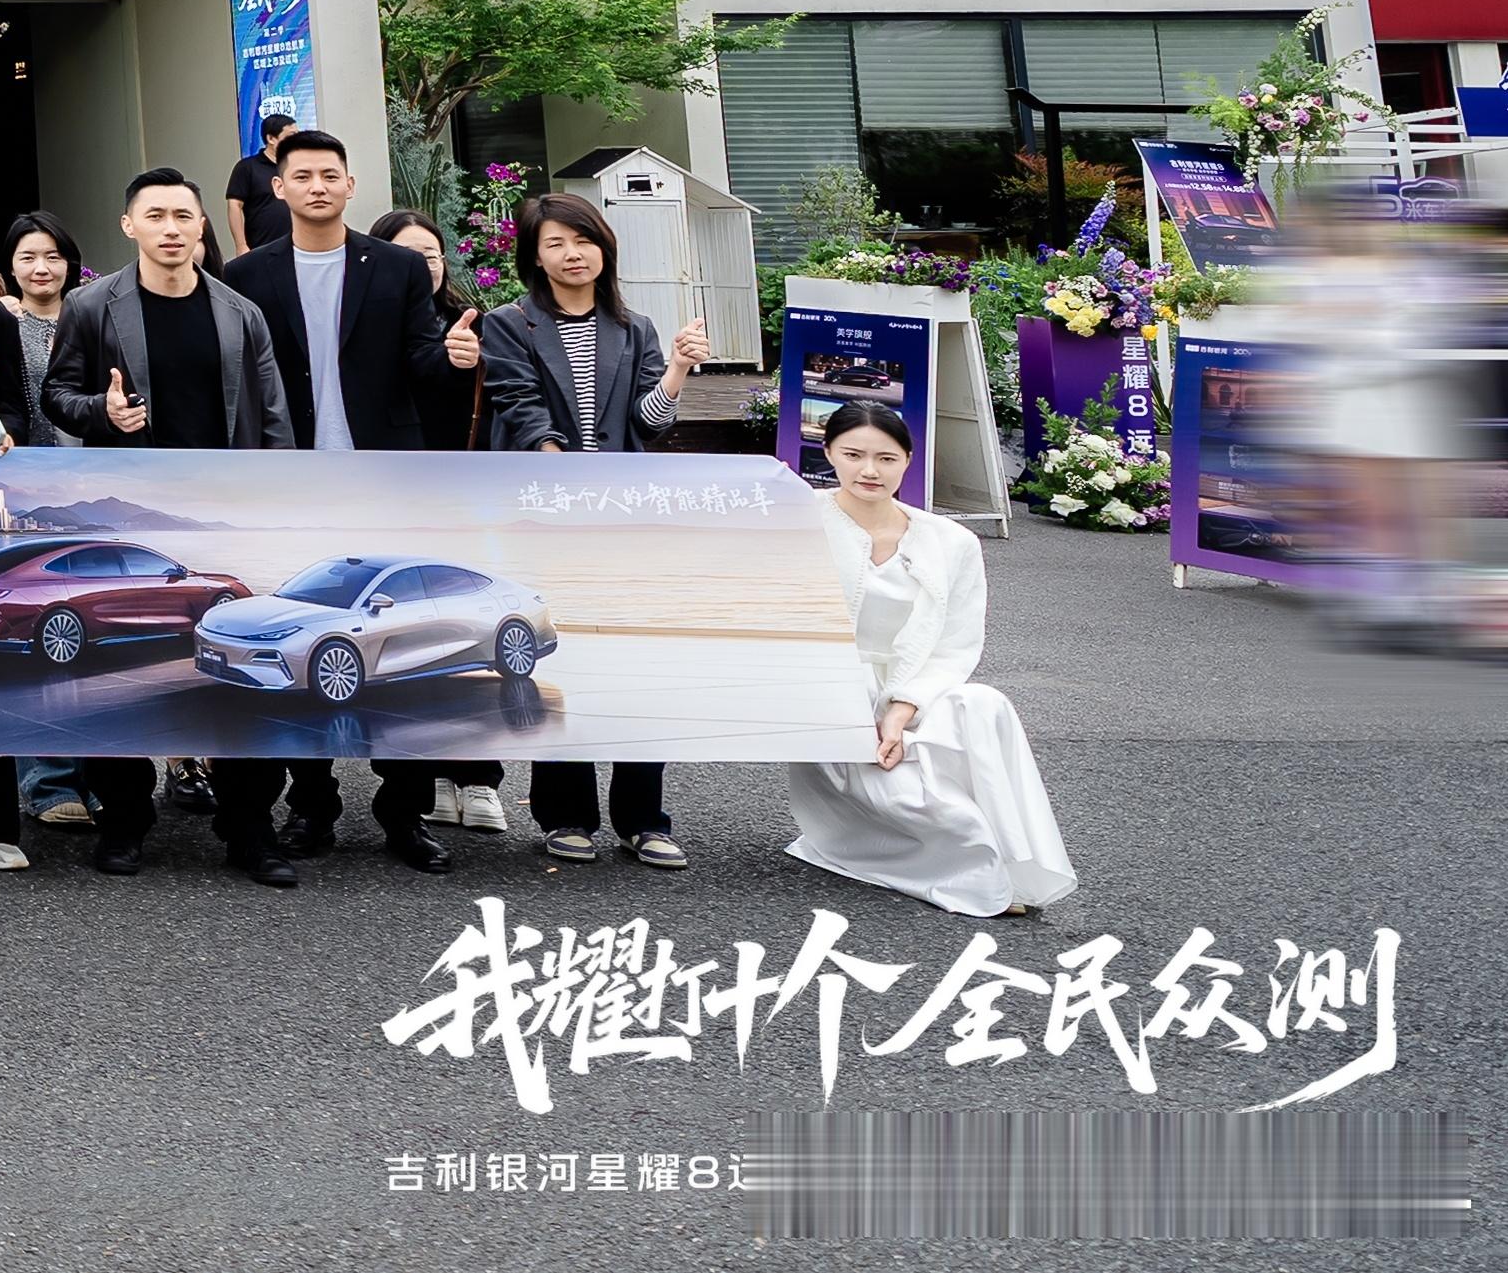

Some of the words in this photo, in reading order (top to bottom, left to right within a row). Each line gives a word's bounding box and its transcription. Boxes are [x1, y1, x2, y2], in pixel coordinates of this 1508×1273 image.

[517, 480, 776, 516] 造每个人的智能精品车
